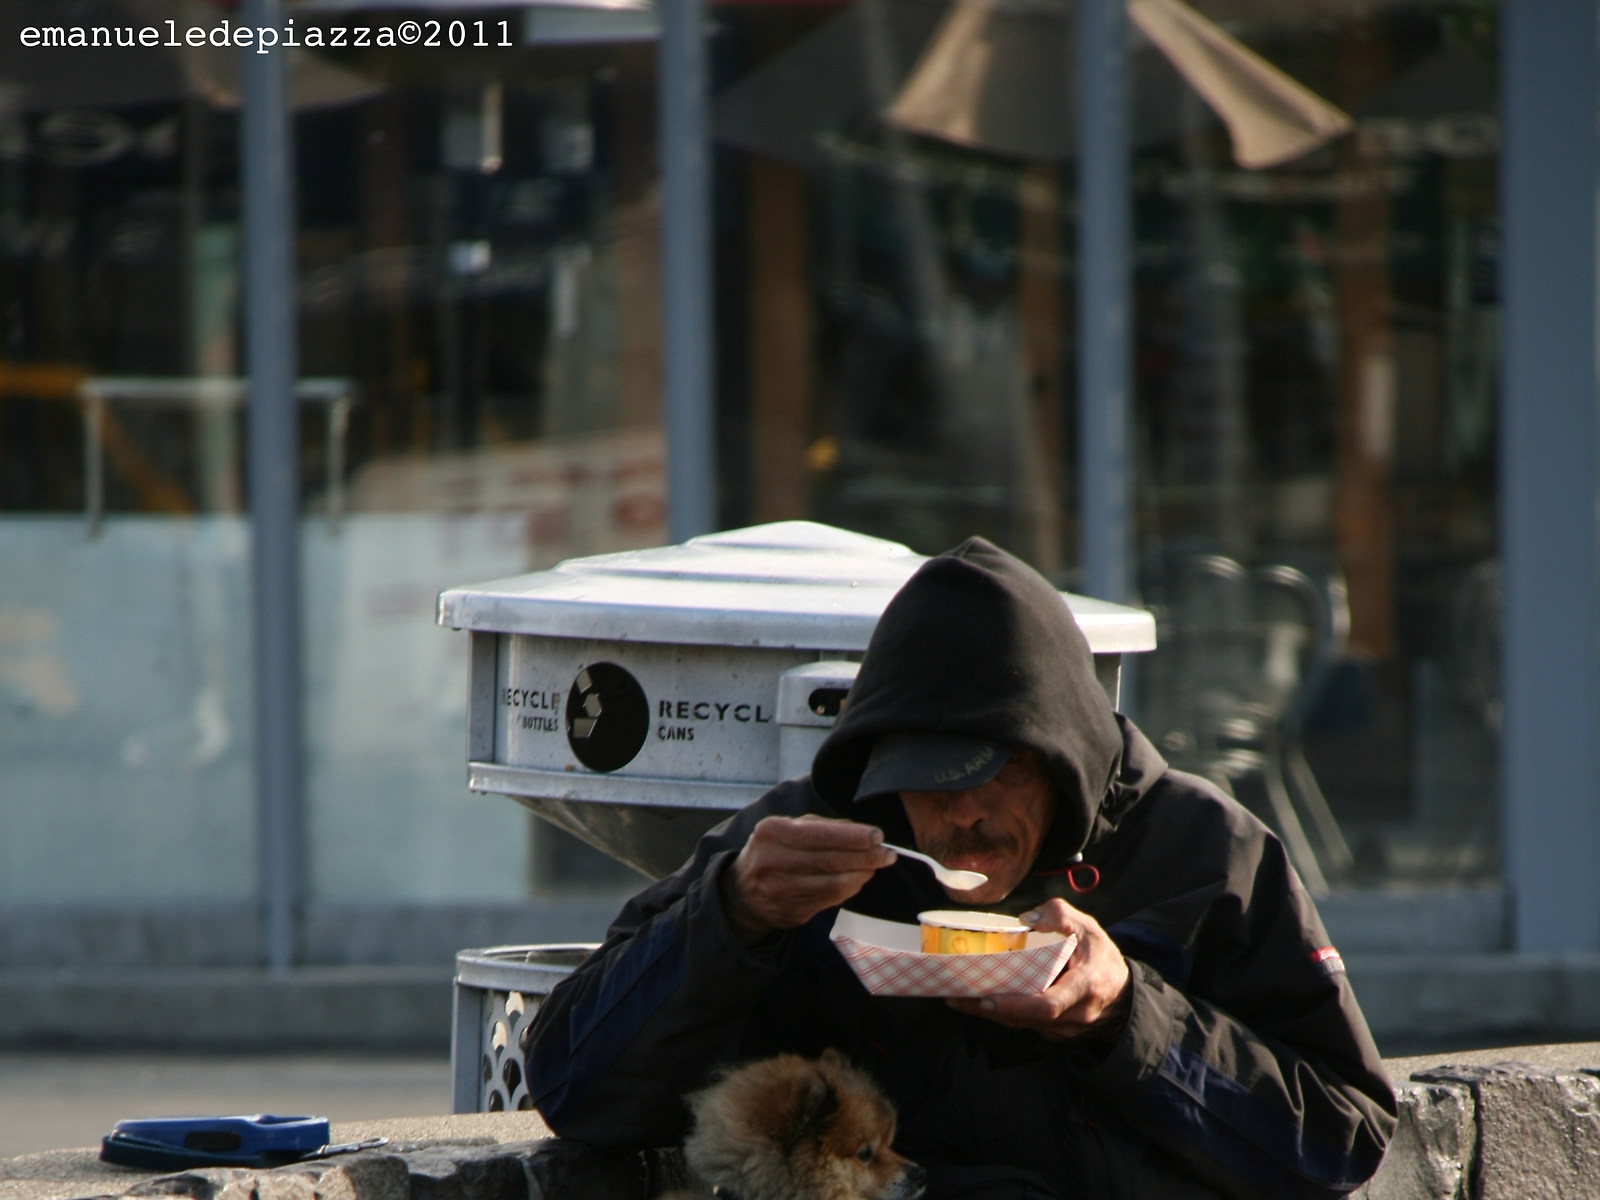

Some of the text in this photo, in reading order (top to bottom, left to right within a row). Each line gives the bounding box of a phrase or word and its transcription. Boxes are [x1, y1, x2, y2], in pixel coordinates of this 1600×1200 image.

[659, 700, 773, 723] RECYCL
[522, 715, 559, 732] BOTTLES
[658, 726, 695, 741] CANS
